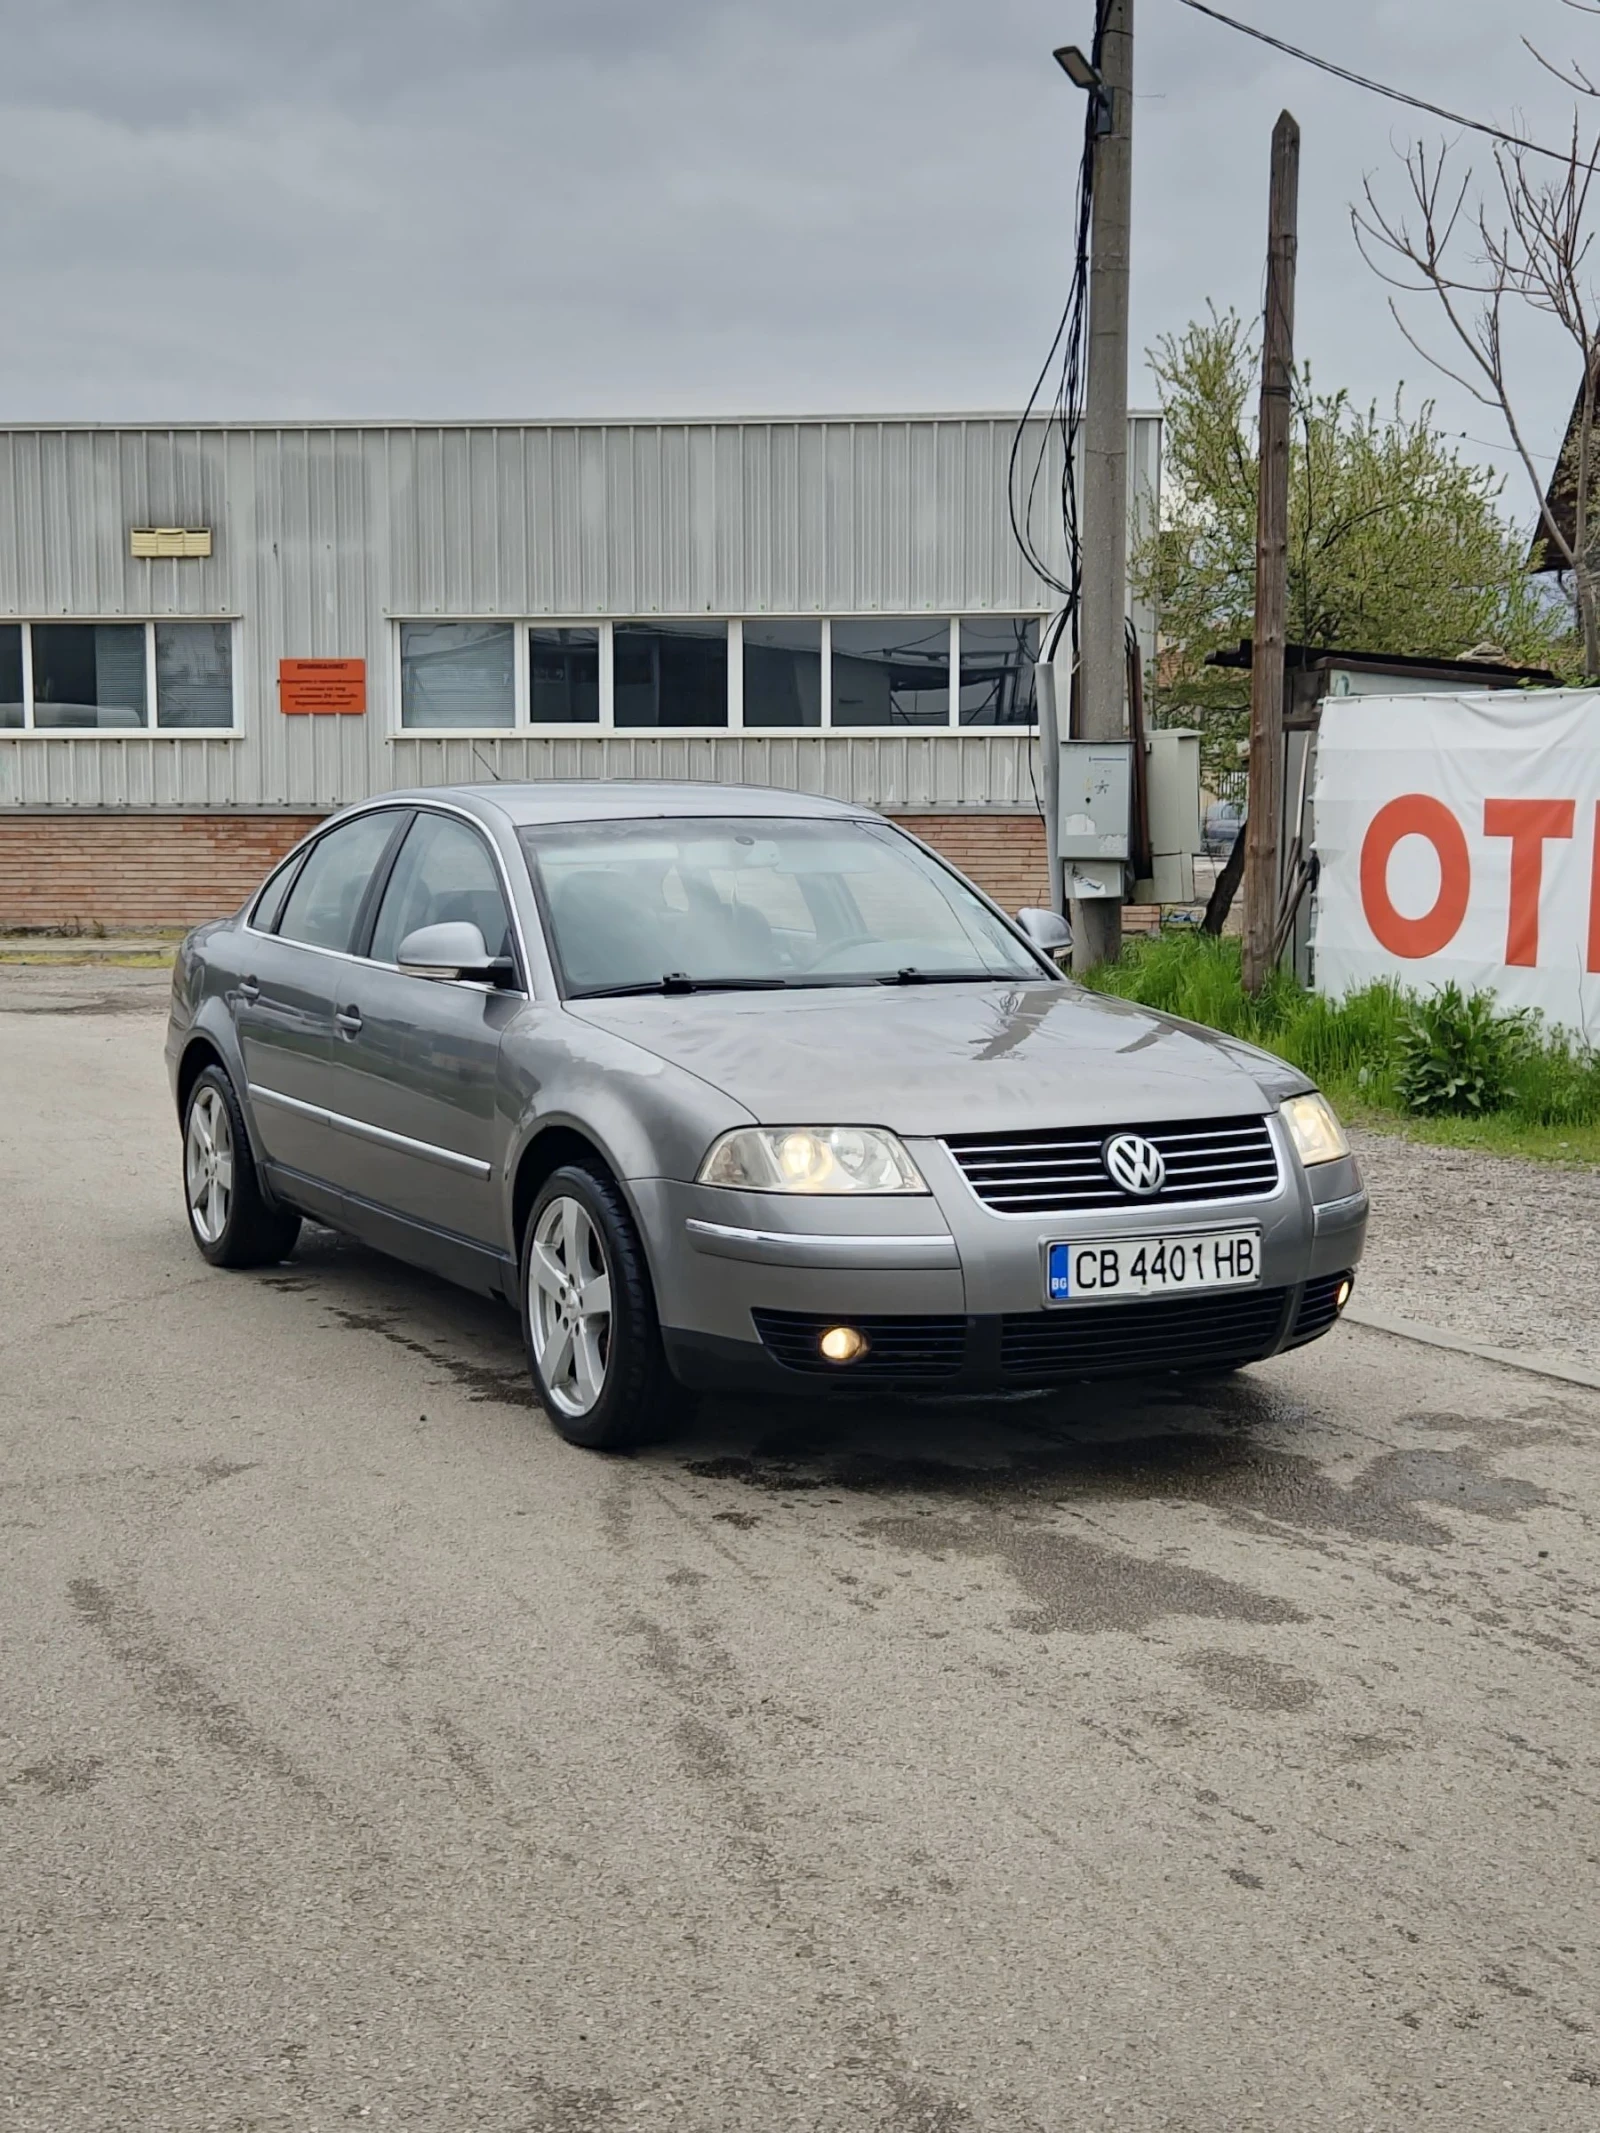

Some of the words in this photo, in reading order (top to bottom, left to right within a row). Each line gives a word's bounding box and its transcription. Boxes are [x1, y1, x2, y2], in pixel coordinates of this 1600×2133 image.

[1360, 793, 1600, 973] ОТ
[1106, 1134, 1165, 1195] VW
[1051, 1277, 1067, 1290] BG
[1076, 1249, 1120, 1289] CB
[1130, 1243, 1204, 1286] 4401
[1214, 1238, 1254, 1279] HB
